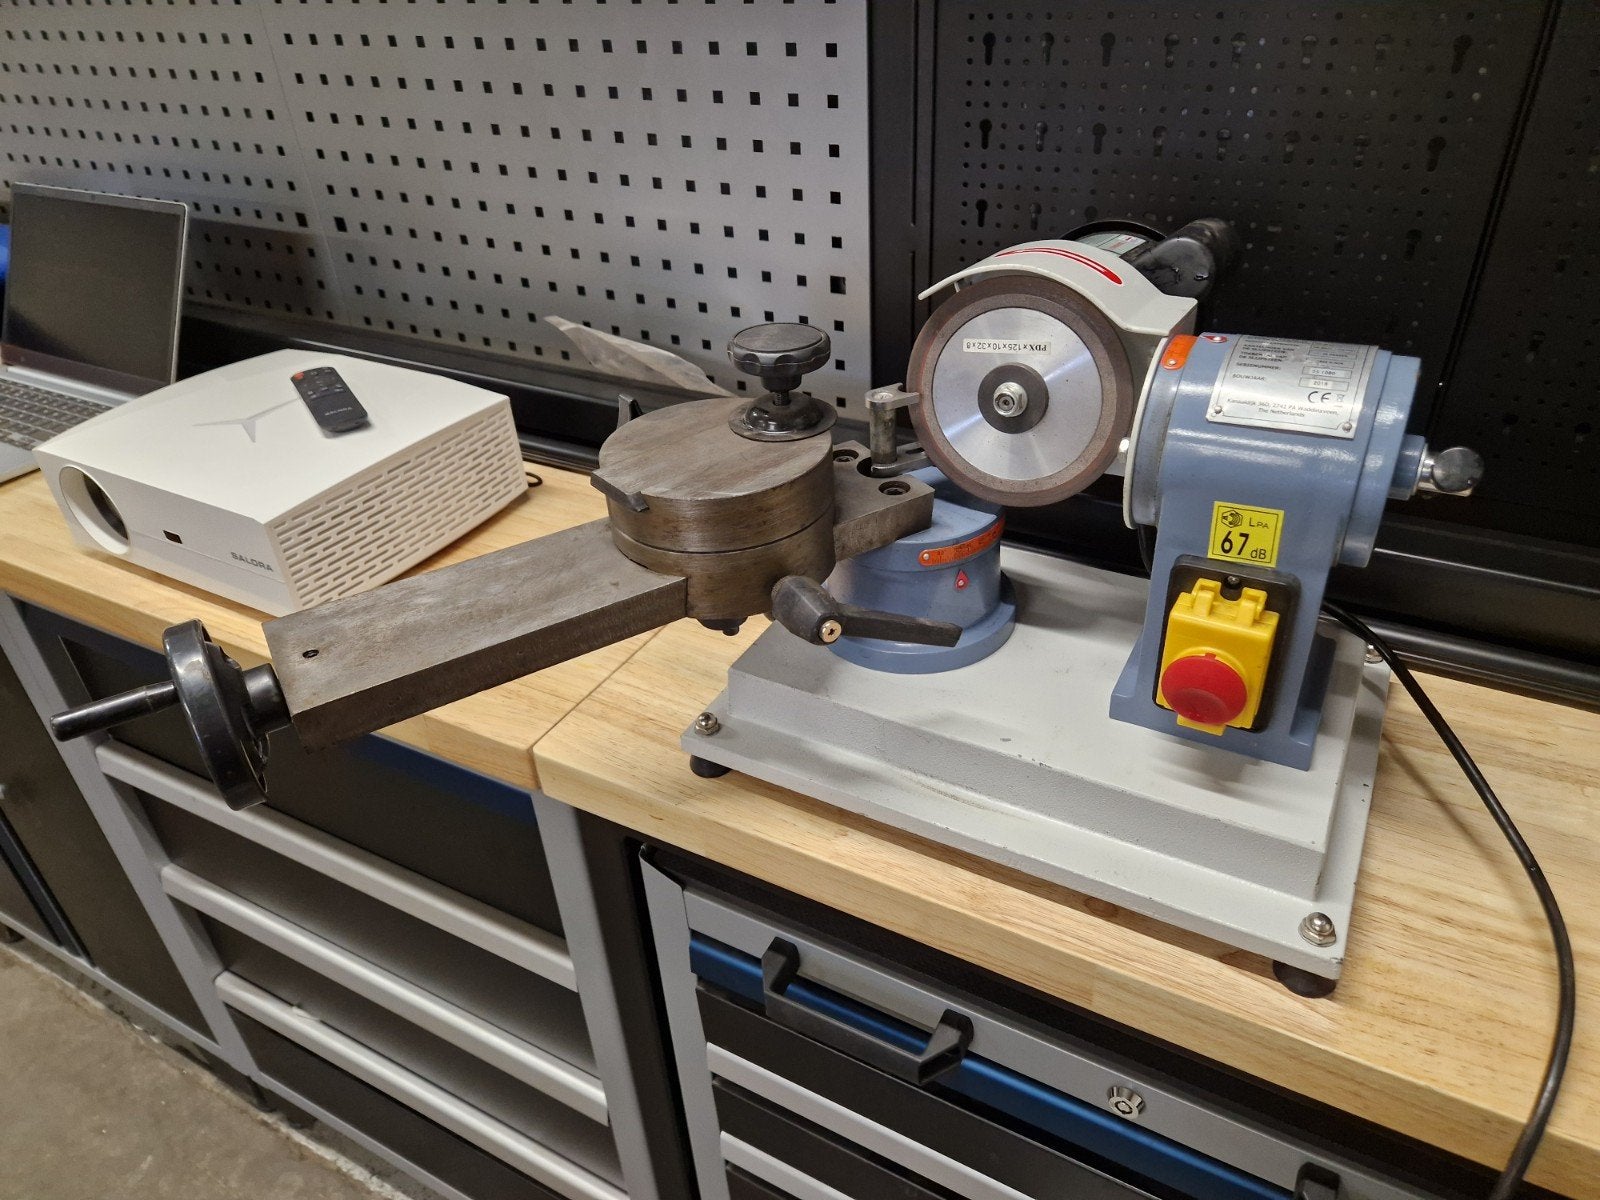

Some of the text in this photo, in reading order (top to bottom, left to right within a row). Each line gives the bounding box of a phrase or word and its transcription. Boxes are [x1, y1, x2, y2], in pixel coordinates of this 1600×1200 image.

[1307, 390, 1332, 404] CE
[1270, 409, 1306, 418] Netherlands
[1220, 530, 1267, 560] 67 dB
[230, 551, 274, 572] SALORA
